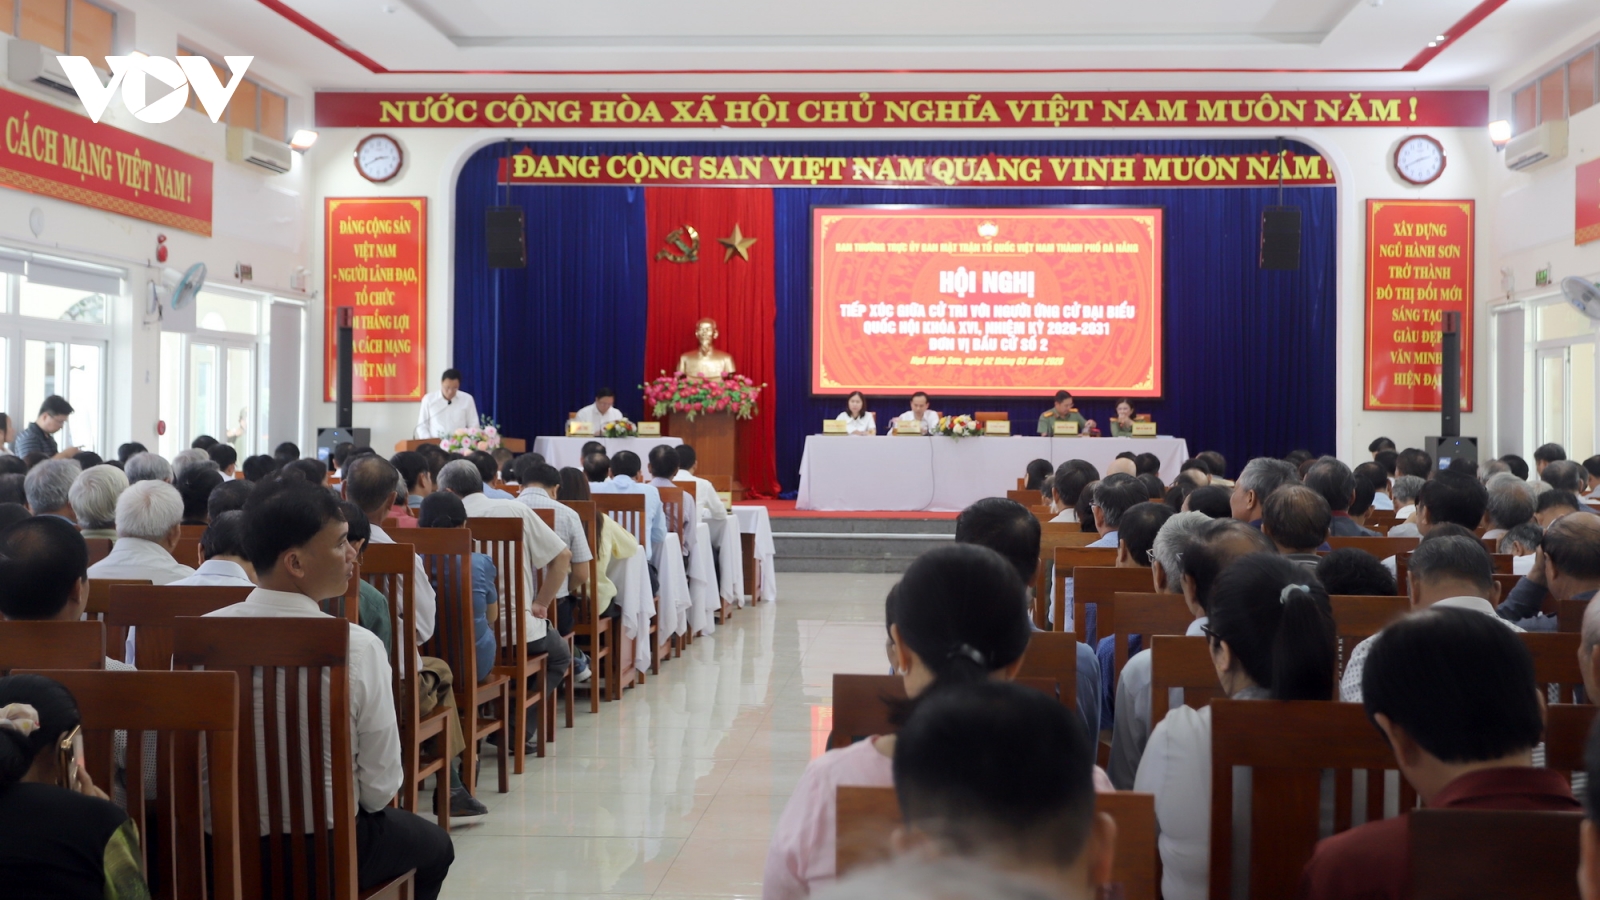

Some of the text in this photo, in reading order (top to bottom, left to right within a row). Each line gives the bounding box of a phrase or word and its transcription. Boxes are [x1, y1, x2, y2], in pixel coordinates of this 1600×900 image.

[380, 94, 477, 122] NƯỚC
[484, 95, 581, 127] CỘNG
[590, 94, 664, 122] HÒA
[671, 95, 718, 122] XÃ
[725, 94, 789, 127] HỘI
[797, 92, 874, 122] CHỦ
[884, 94, 1000, 122] NGHĨA
[1006, 94, 1093, 127] VIỆT
[1102, 100, 1188, 122] NAM
[1196, 93, 1307, 122] MUÔN
[1314, 92, 1401, 122] NĂM
[6, 110, 58, 166] CÁCH
[62, 134, 112, 182] MẠNG
[116, 148, 152, 197] VIỆT
[852, 158, 926, 181] NAM
[932, 158, 1042, 185] QUANG
[1049, 158, 1135, 181] VINH
[339, 216, 411, 238] ĐẢNG CỘNG SẢN
[1394, 220, 1447, 240] XÂY DỰNG
[354, 240, 396, 262] VIỆT NAM
[1379, 242, 1460, 258] NGŨ HÀNH SƠN
[338, 264, 368, 282] NGƯỜI
[370, 264, 394, 282] LÃNH
[395, 268, 417, 286] ĐẠO,
[1389, 262, 1451, 279] TRỞ THÀNH
[939, 266, 1034, 298] HỘI NGHỊ
[1376, 282, 1462, 304] ĐÔ THỊ ĐỔI MỚI
[355, 284, 395, 306] TỔ CHỨC
[361, 308, 391, 329] THẮNG
[394, 314, 409, 333] LỢI
[1392, 305, 1442, 325] SÁNG TẠO
[359, 335, 383, 353] CÁCH
[384, 339, 411, 357] MẠNG
[929, 336, 955, 350] ĐƠN
[958, 338, 970, 353] VỊ
[1000, 336, 1018, 351] CỬ
[1020, 335, 1037, 351] SỐ
[1040, 338, 1048, 351] 2
[1394, 327, 1442, 347] GIÀU ĐẸP
[1390, 348, 1442, 364] VĂN MINH
[353, 360, 396, 382] VIỆT NAM
[1394, 370, 1420, 389] HIỆN
